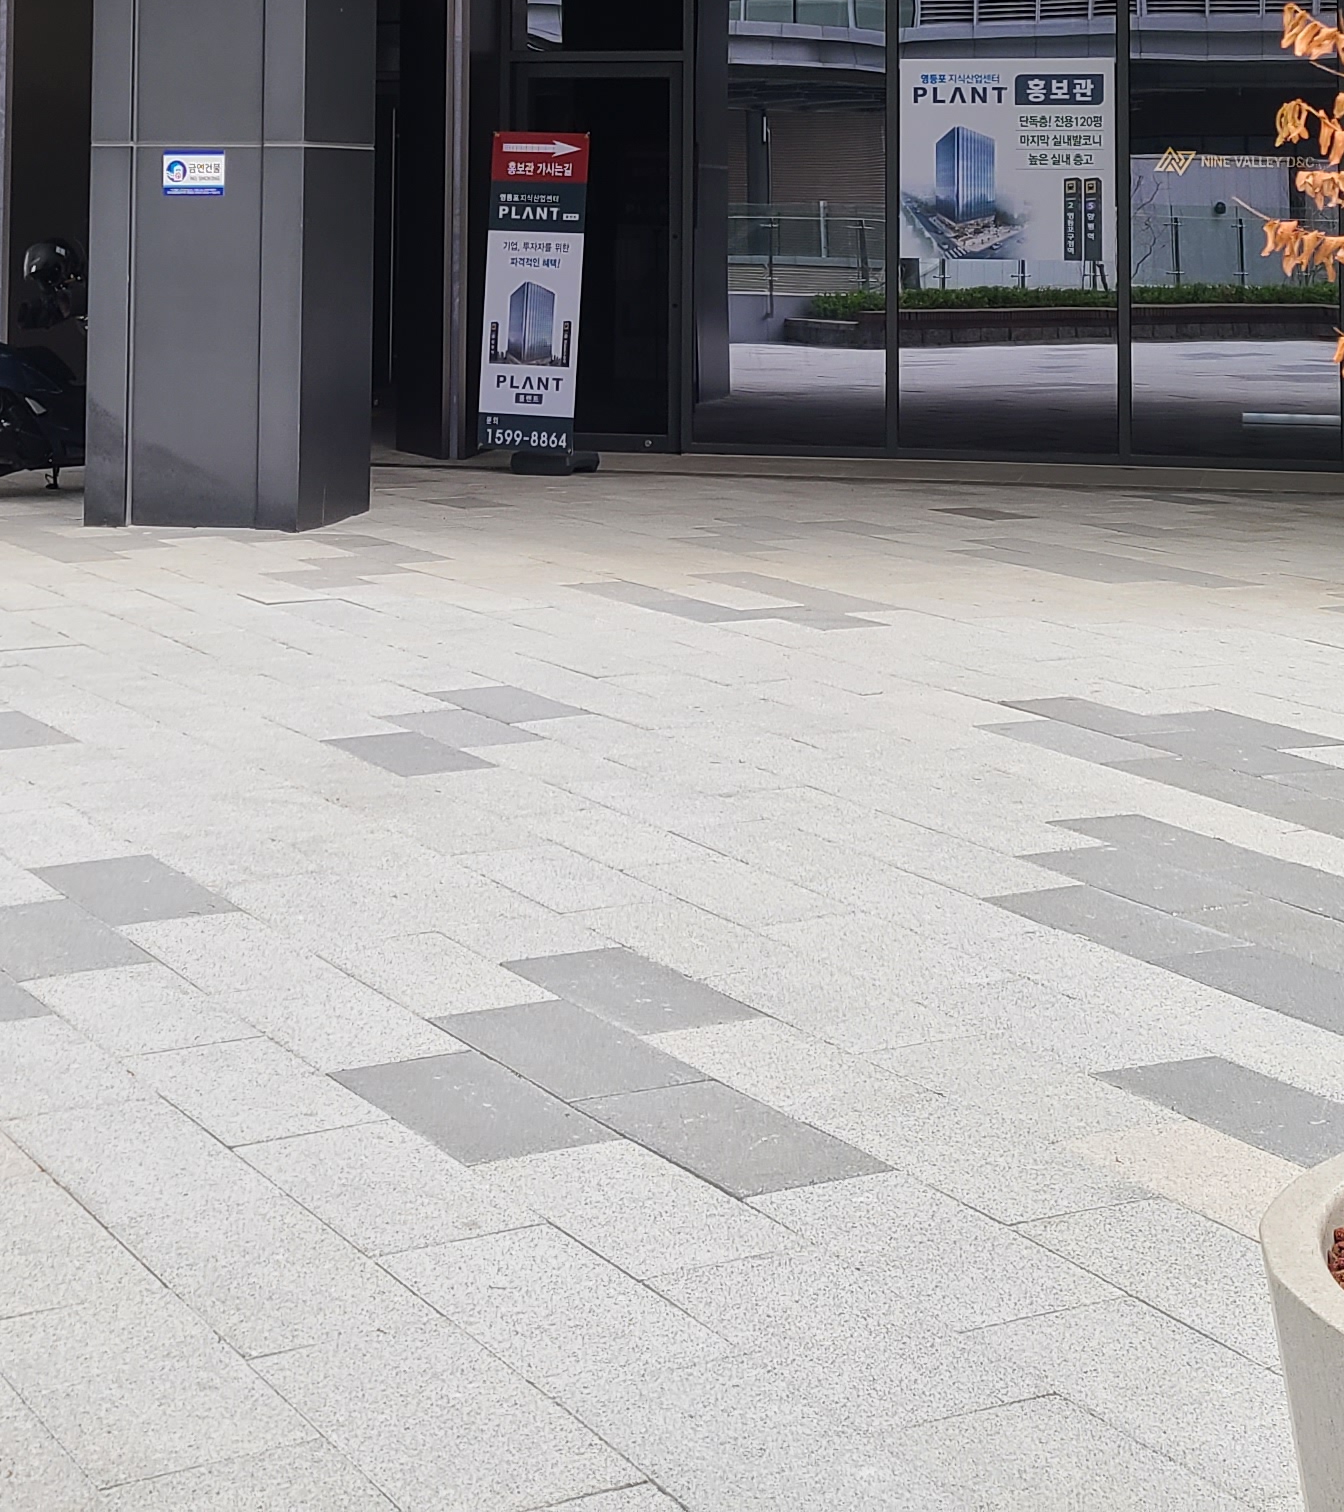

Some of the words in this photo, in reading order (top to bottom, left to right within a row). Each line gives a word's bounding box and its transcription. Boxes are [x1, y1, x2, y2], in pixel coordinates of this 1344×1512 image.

[913, 86, 1008, 104] PLANT
[1026, 78, 1095, 102] 홍보관
[1019, 134, 1050, 147] 마지막
[1051, 153, 1071, 166] 실내
[1201, 155, 1232, 168] NINE
[1235, 155, 1282, 168] VALLEY
[188, 163, 221, 174] 금연건물
[507, 161, 535, 176] 홍보관
[536, 162, 573, 177] 가시는길
[498, 205, 561, 221] PLANT
[496, 374, 564, 392] PLANT
[486, 428, 567, 448] 1599-8864
